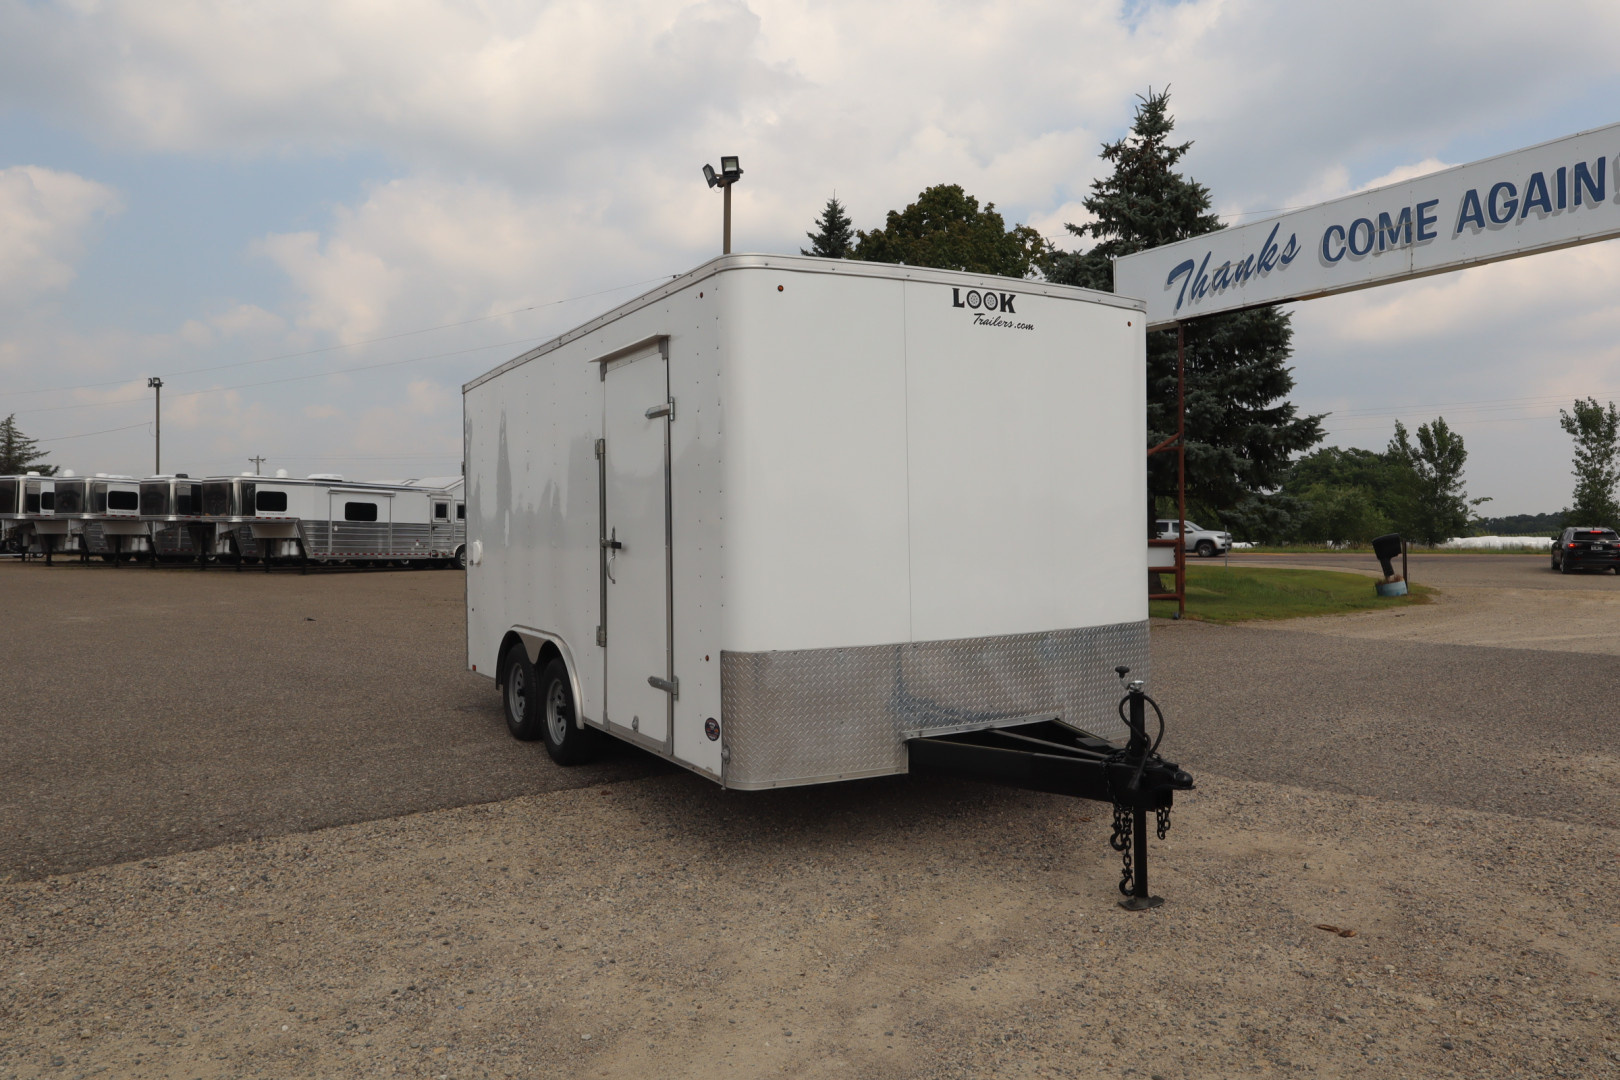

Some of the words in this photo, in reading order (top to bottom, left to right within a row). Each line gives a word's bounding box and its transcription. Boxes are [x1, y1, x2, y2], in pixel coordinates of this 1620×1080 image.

[1166, 222, 1301, 311] Thanks
[1322, 199, 1439, 262] COME
[1455, 152, 1620, 234] AGAIN
[952, 287, 1016, 314] LOOK
[973, 313, 1034, 331] Trailers.com
